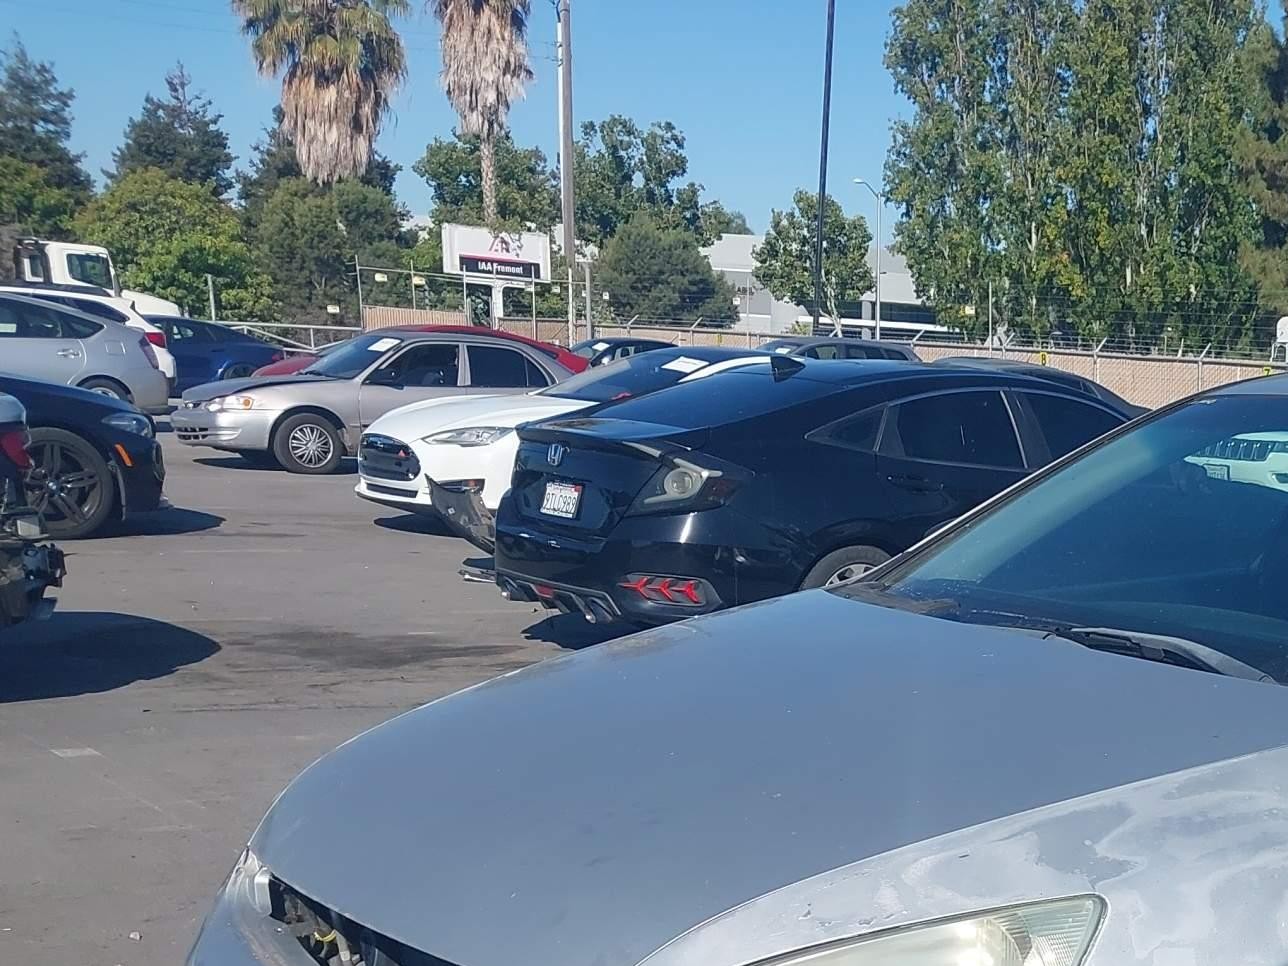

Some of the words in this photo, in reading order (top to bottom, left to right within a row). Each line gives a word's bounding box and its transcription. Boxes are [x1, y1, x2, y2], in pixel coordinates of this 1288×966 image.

[478, 261, 492, 271] IAA
[493, 263, 523, 274] Fremont
[1264, 368, 1271, 377] 7
